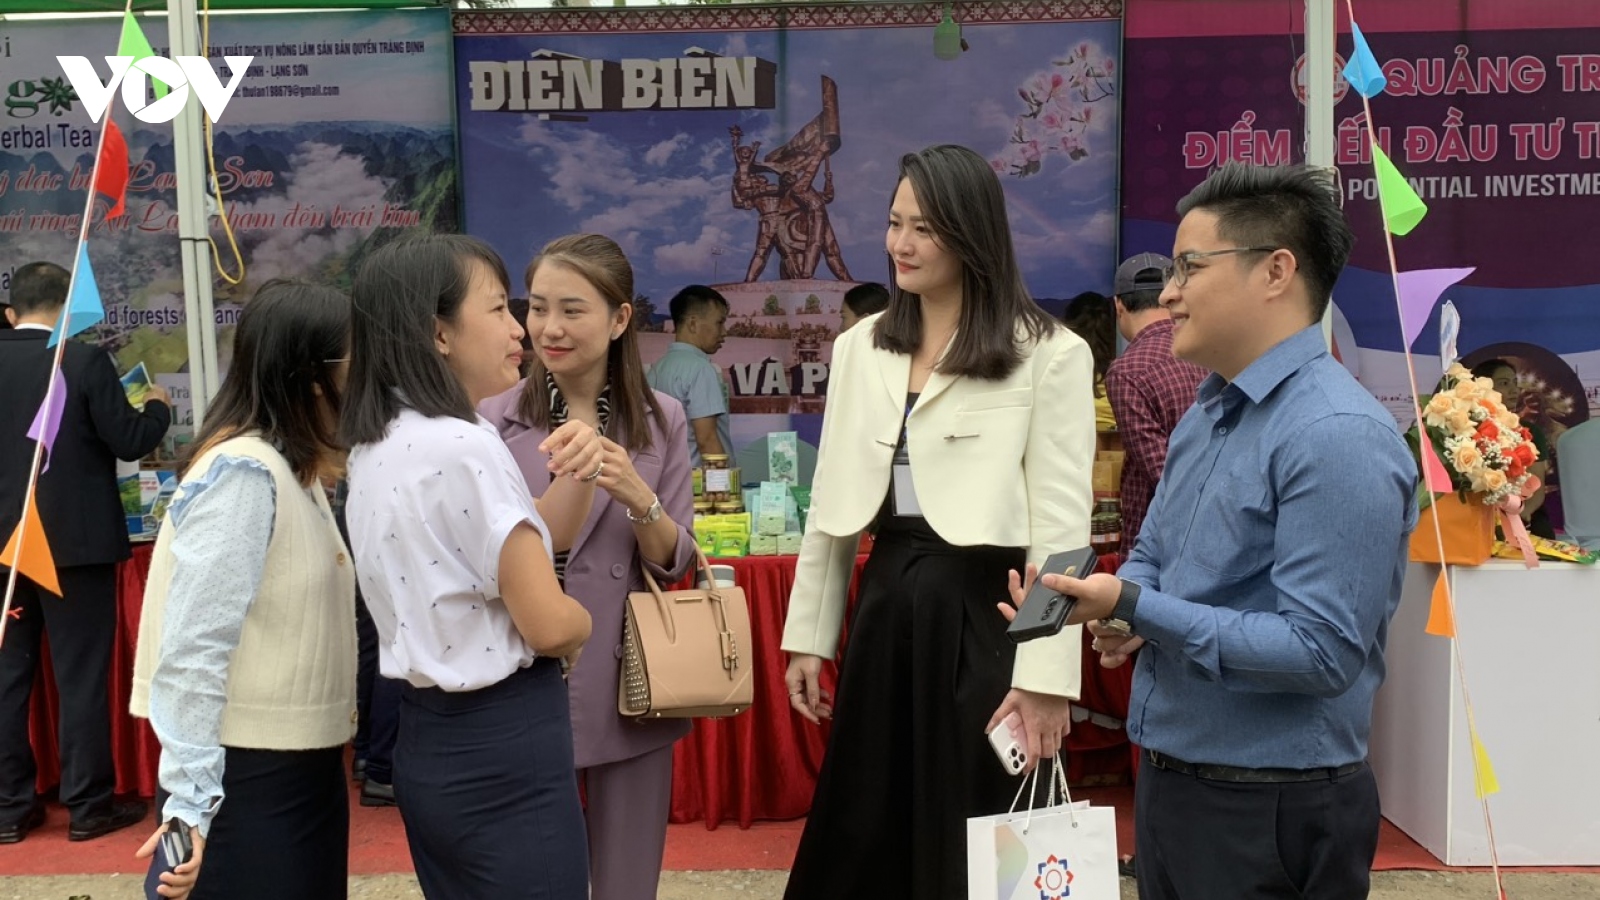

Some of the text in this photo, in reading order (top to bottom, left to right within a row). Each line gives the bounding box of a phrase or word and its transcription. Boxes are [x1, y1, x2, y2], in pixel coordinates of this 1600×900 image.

[469, 46, 757, 121] ĐIỆN BIÊN
[1380, 44, 1547, 97] QUẢNG
[58, 123, 92, 148] Tea
[1182, 110, 1291, 169] ĐIỂM
[1334, 110, 1391, 165] ẾN
[1403, 106, 1498, 163] ĐẦU
[1509, 116, 1566, 161] TƯ
[122, 305, 179, 325] forests
[733, 356, 792, 396] VÀ
